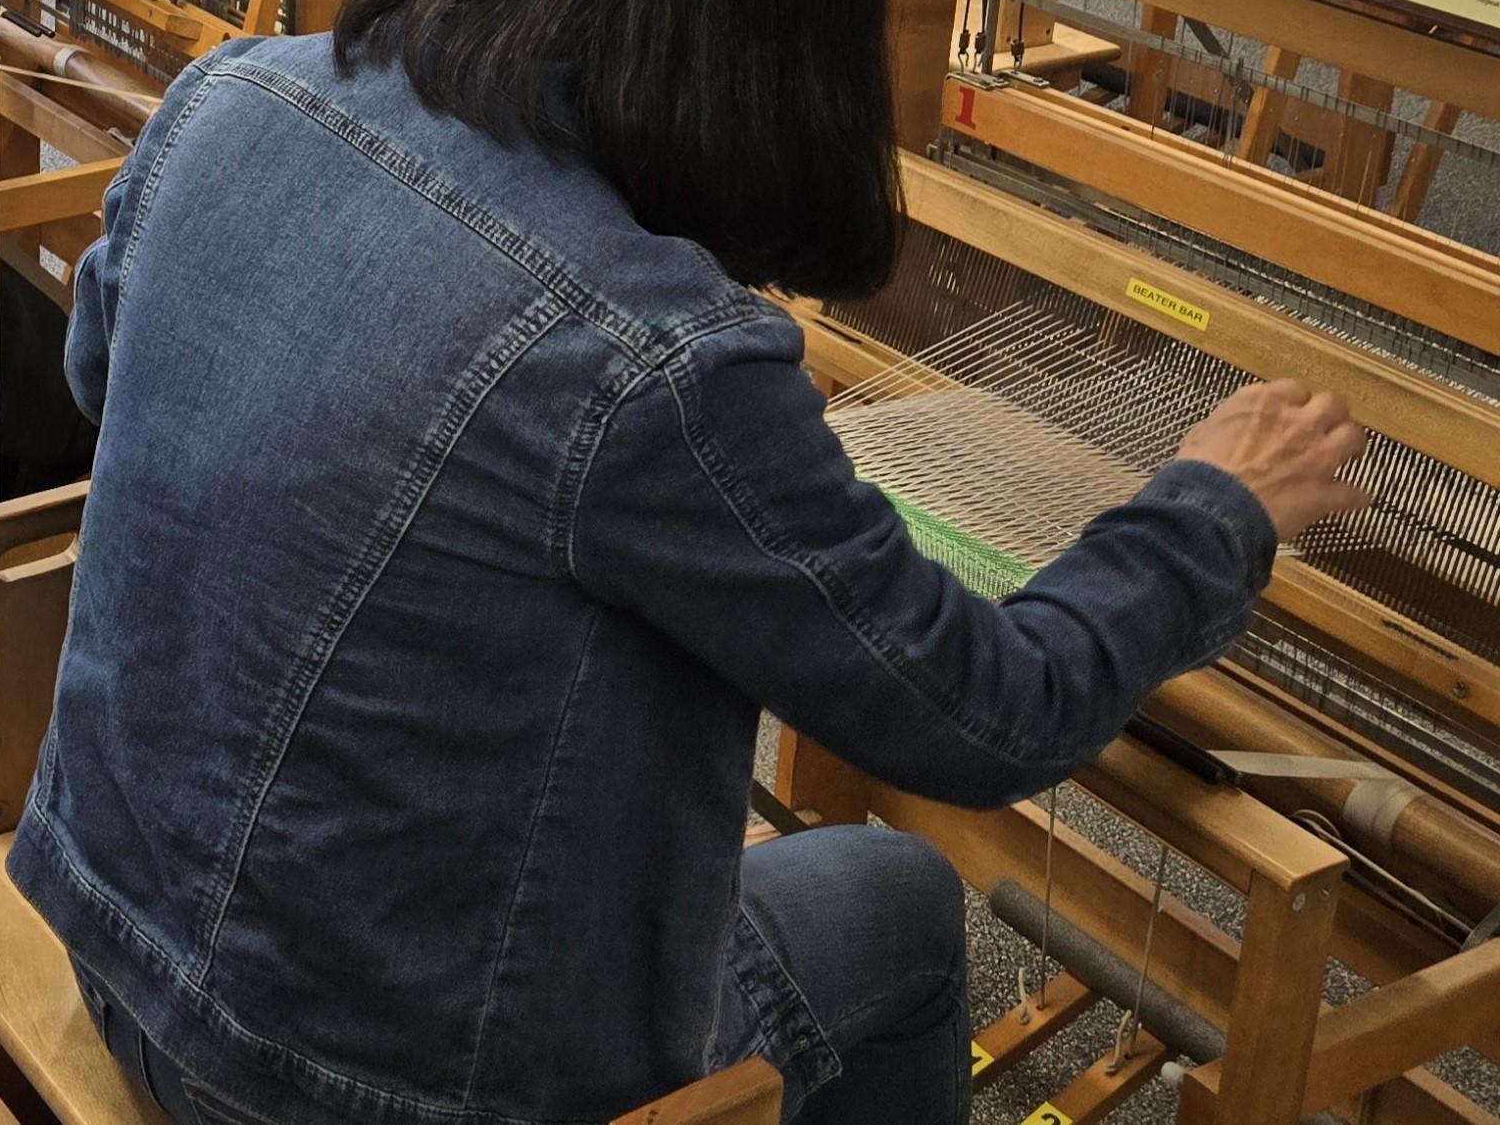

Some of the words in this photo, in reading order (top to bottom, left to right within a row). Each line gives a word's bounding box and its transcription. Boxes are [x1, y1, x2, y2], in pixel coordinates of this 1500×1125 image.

[955, 86, 977, 130] 1
[1132, 283, 1178, 311] BEATER
[1179, 305, 1204, 323] BAR
